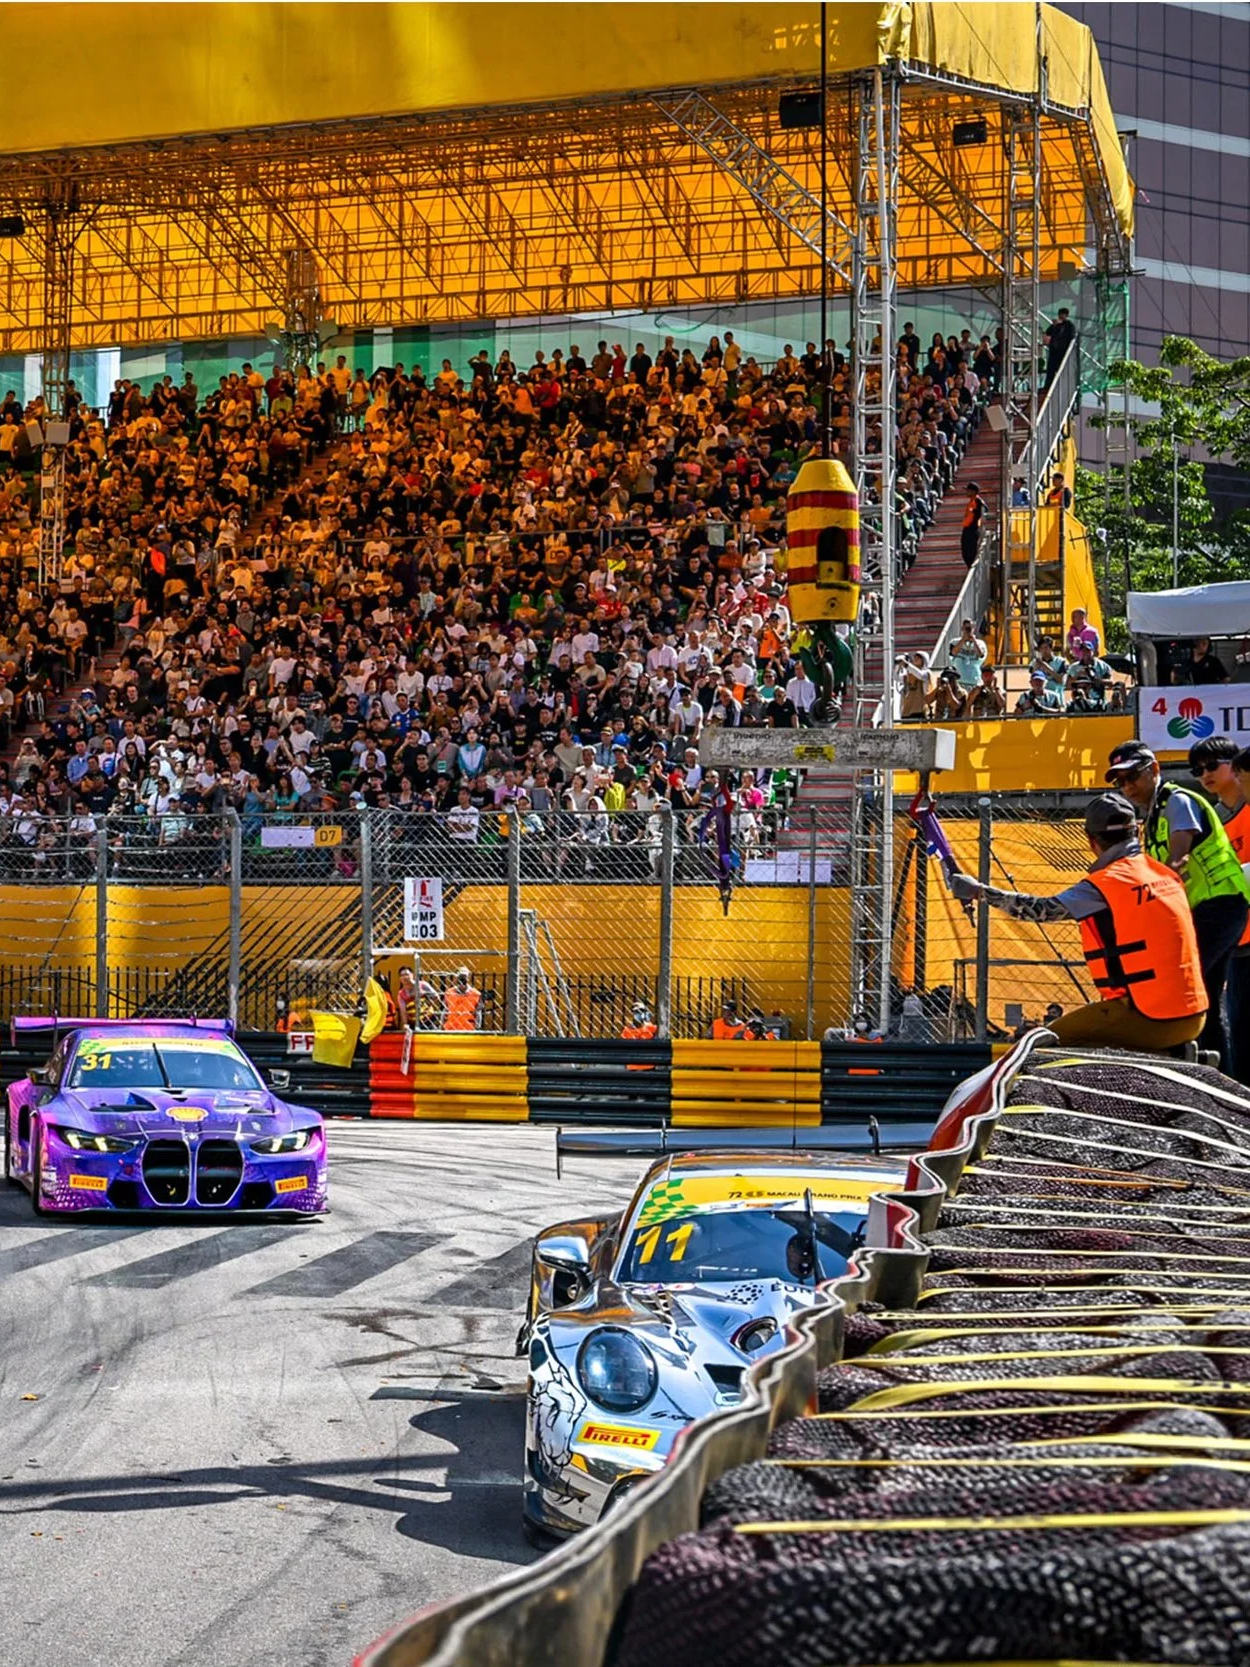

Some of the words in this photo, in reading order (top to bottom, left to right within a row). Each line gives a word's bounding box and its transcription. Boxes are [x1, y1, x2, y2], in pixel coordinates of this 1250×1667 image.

[1152, 697, 1167, 715] 4
[319, 829, 336, 842] D7
[1131, 883, 1156, 906] 72
[419, 911, 437, 921] MP
[419, 924, 437, 938] 03
[81, 1053, 112, 1071] 31
[729, 1191, 743, 1199] 72
[636, 1224, 694, 1265] 11
[583, 1426, 651, 1446] PIRELLI
